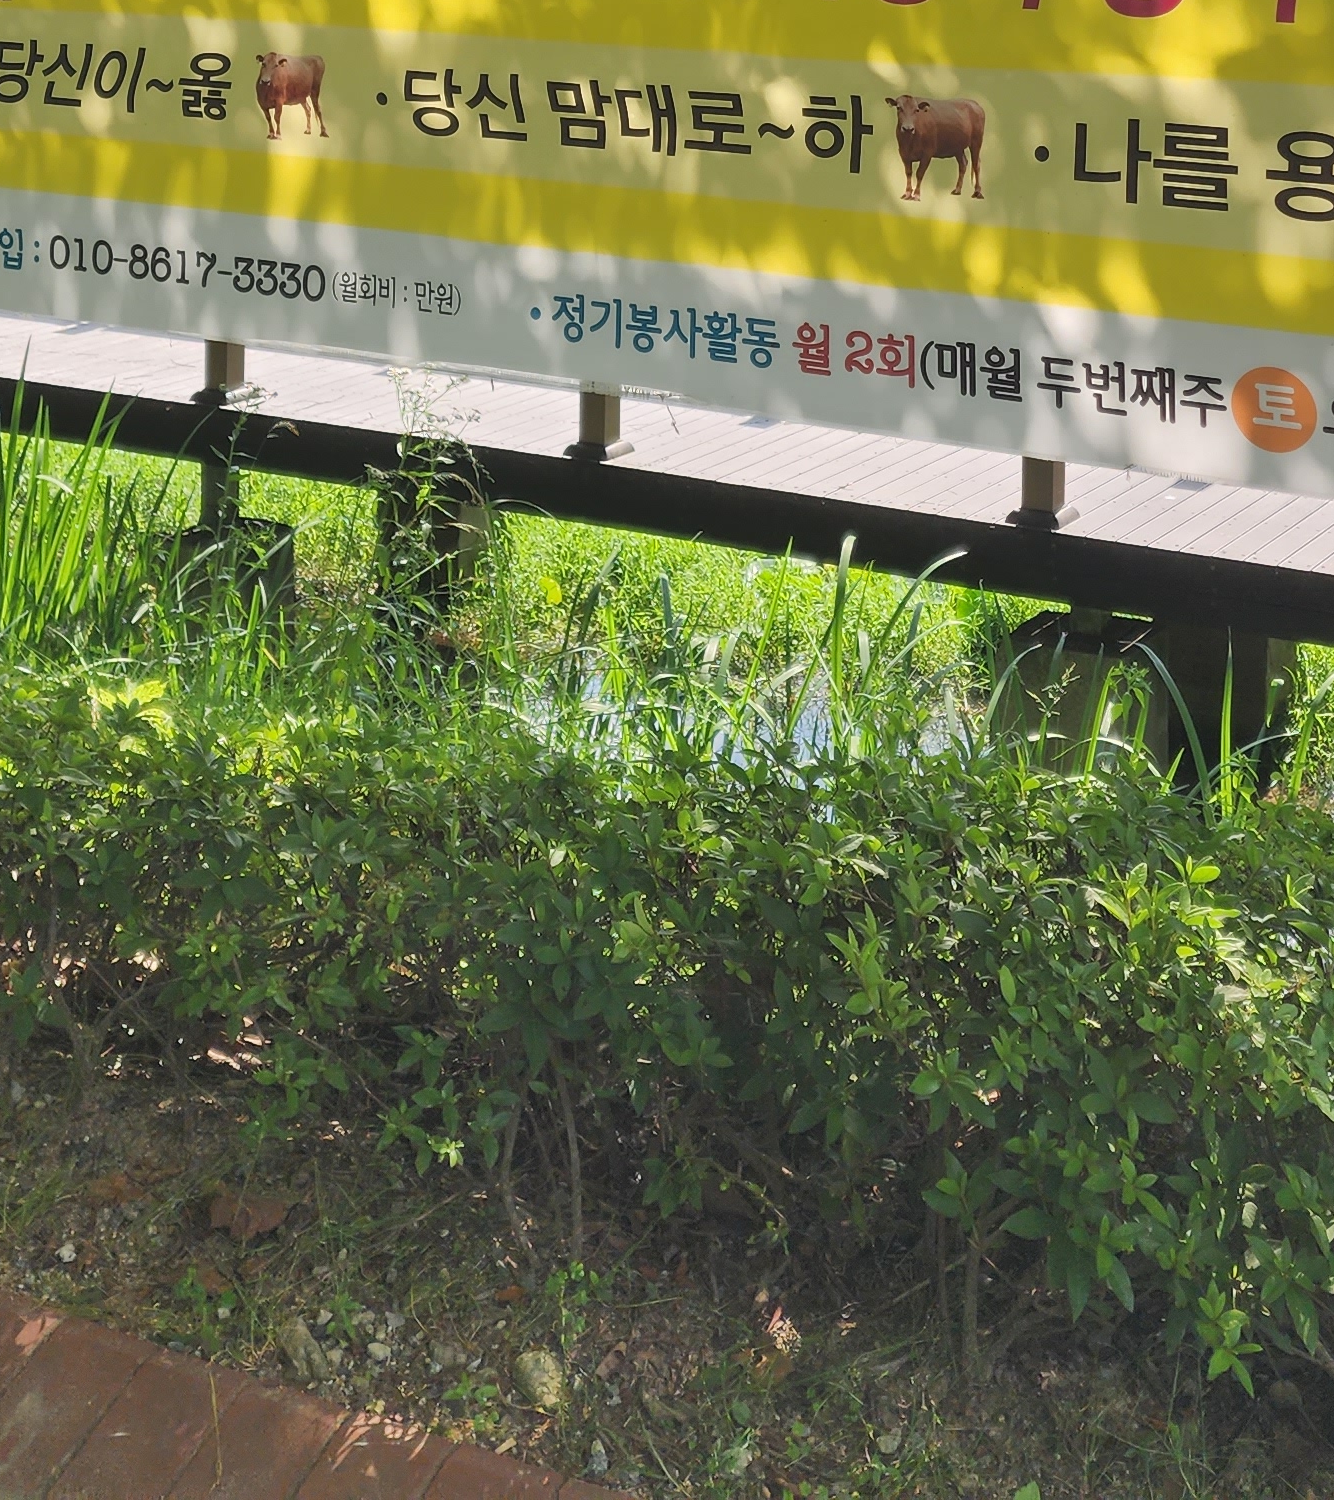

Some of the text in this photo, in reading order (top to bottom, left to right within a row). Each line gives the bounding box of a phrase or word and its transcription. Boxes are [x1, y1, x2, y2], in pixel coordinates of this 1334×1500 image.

[48, 233, 327, 303] 010-8617-3330
[550, 293, 781, 370] 정기봉사활동
[1036, 355, 1230, 429] 두번째주
